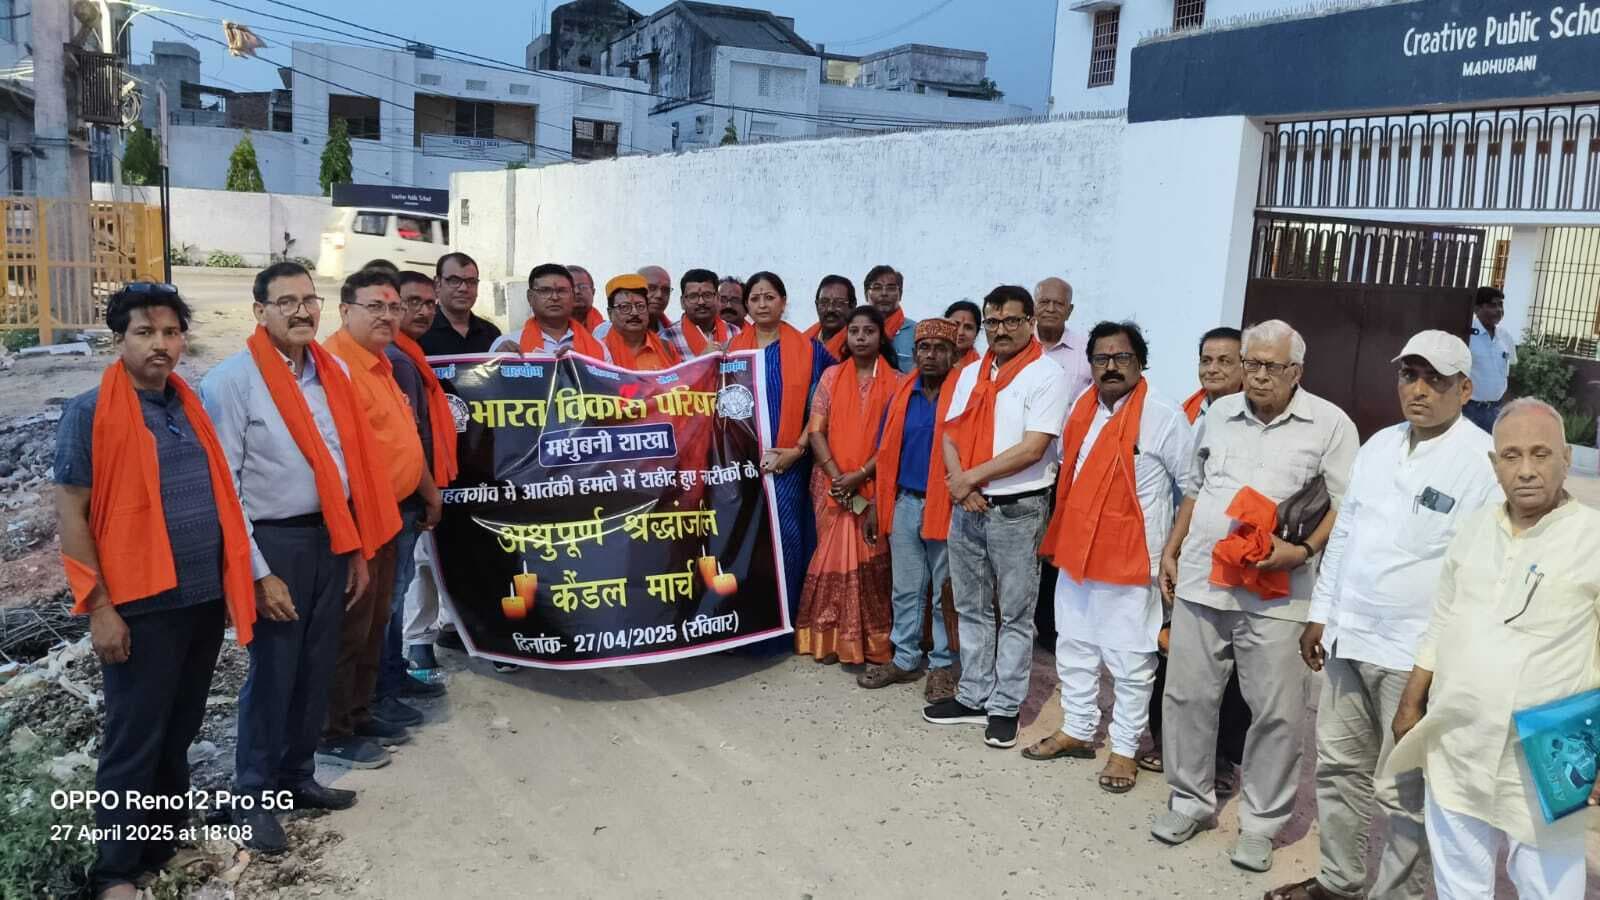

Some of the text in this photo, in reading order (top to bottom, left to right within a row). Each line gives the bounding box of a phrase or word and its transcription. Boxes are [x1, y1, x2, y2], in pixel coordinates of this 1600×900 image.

[1403, 22, 1477, 57] Creative
[1485, 10, 1541, 47] Public
[1462, 55, 1537, 77] MADHUBANI
[469, 399, 546, 428] भारत
[555, 387, 647, 424] विकास
[545, 430, 669, 461] मधुबनी शाखा
[522, 474, 574, 500] आतंकी
[578, 470, 618, 493] हमले
[621, 468, 636, 489] में
[640, 466, 677, 488] शहीद
[679, 469, 697, 491] हुए
[497, 506, 604, 561] अश्रुपूर्ण
[645, 559, 694, 603] मार्च
[573, 624, 677, 653] 27/04/2025
[681, 610, 739, 642] (रविवार)
